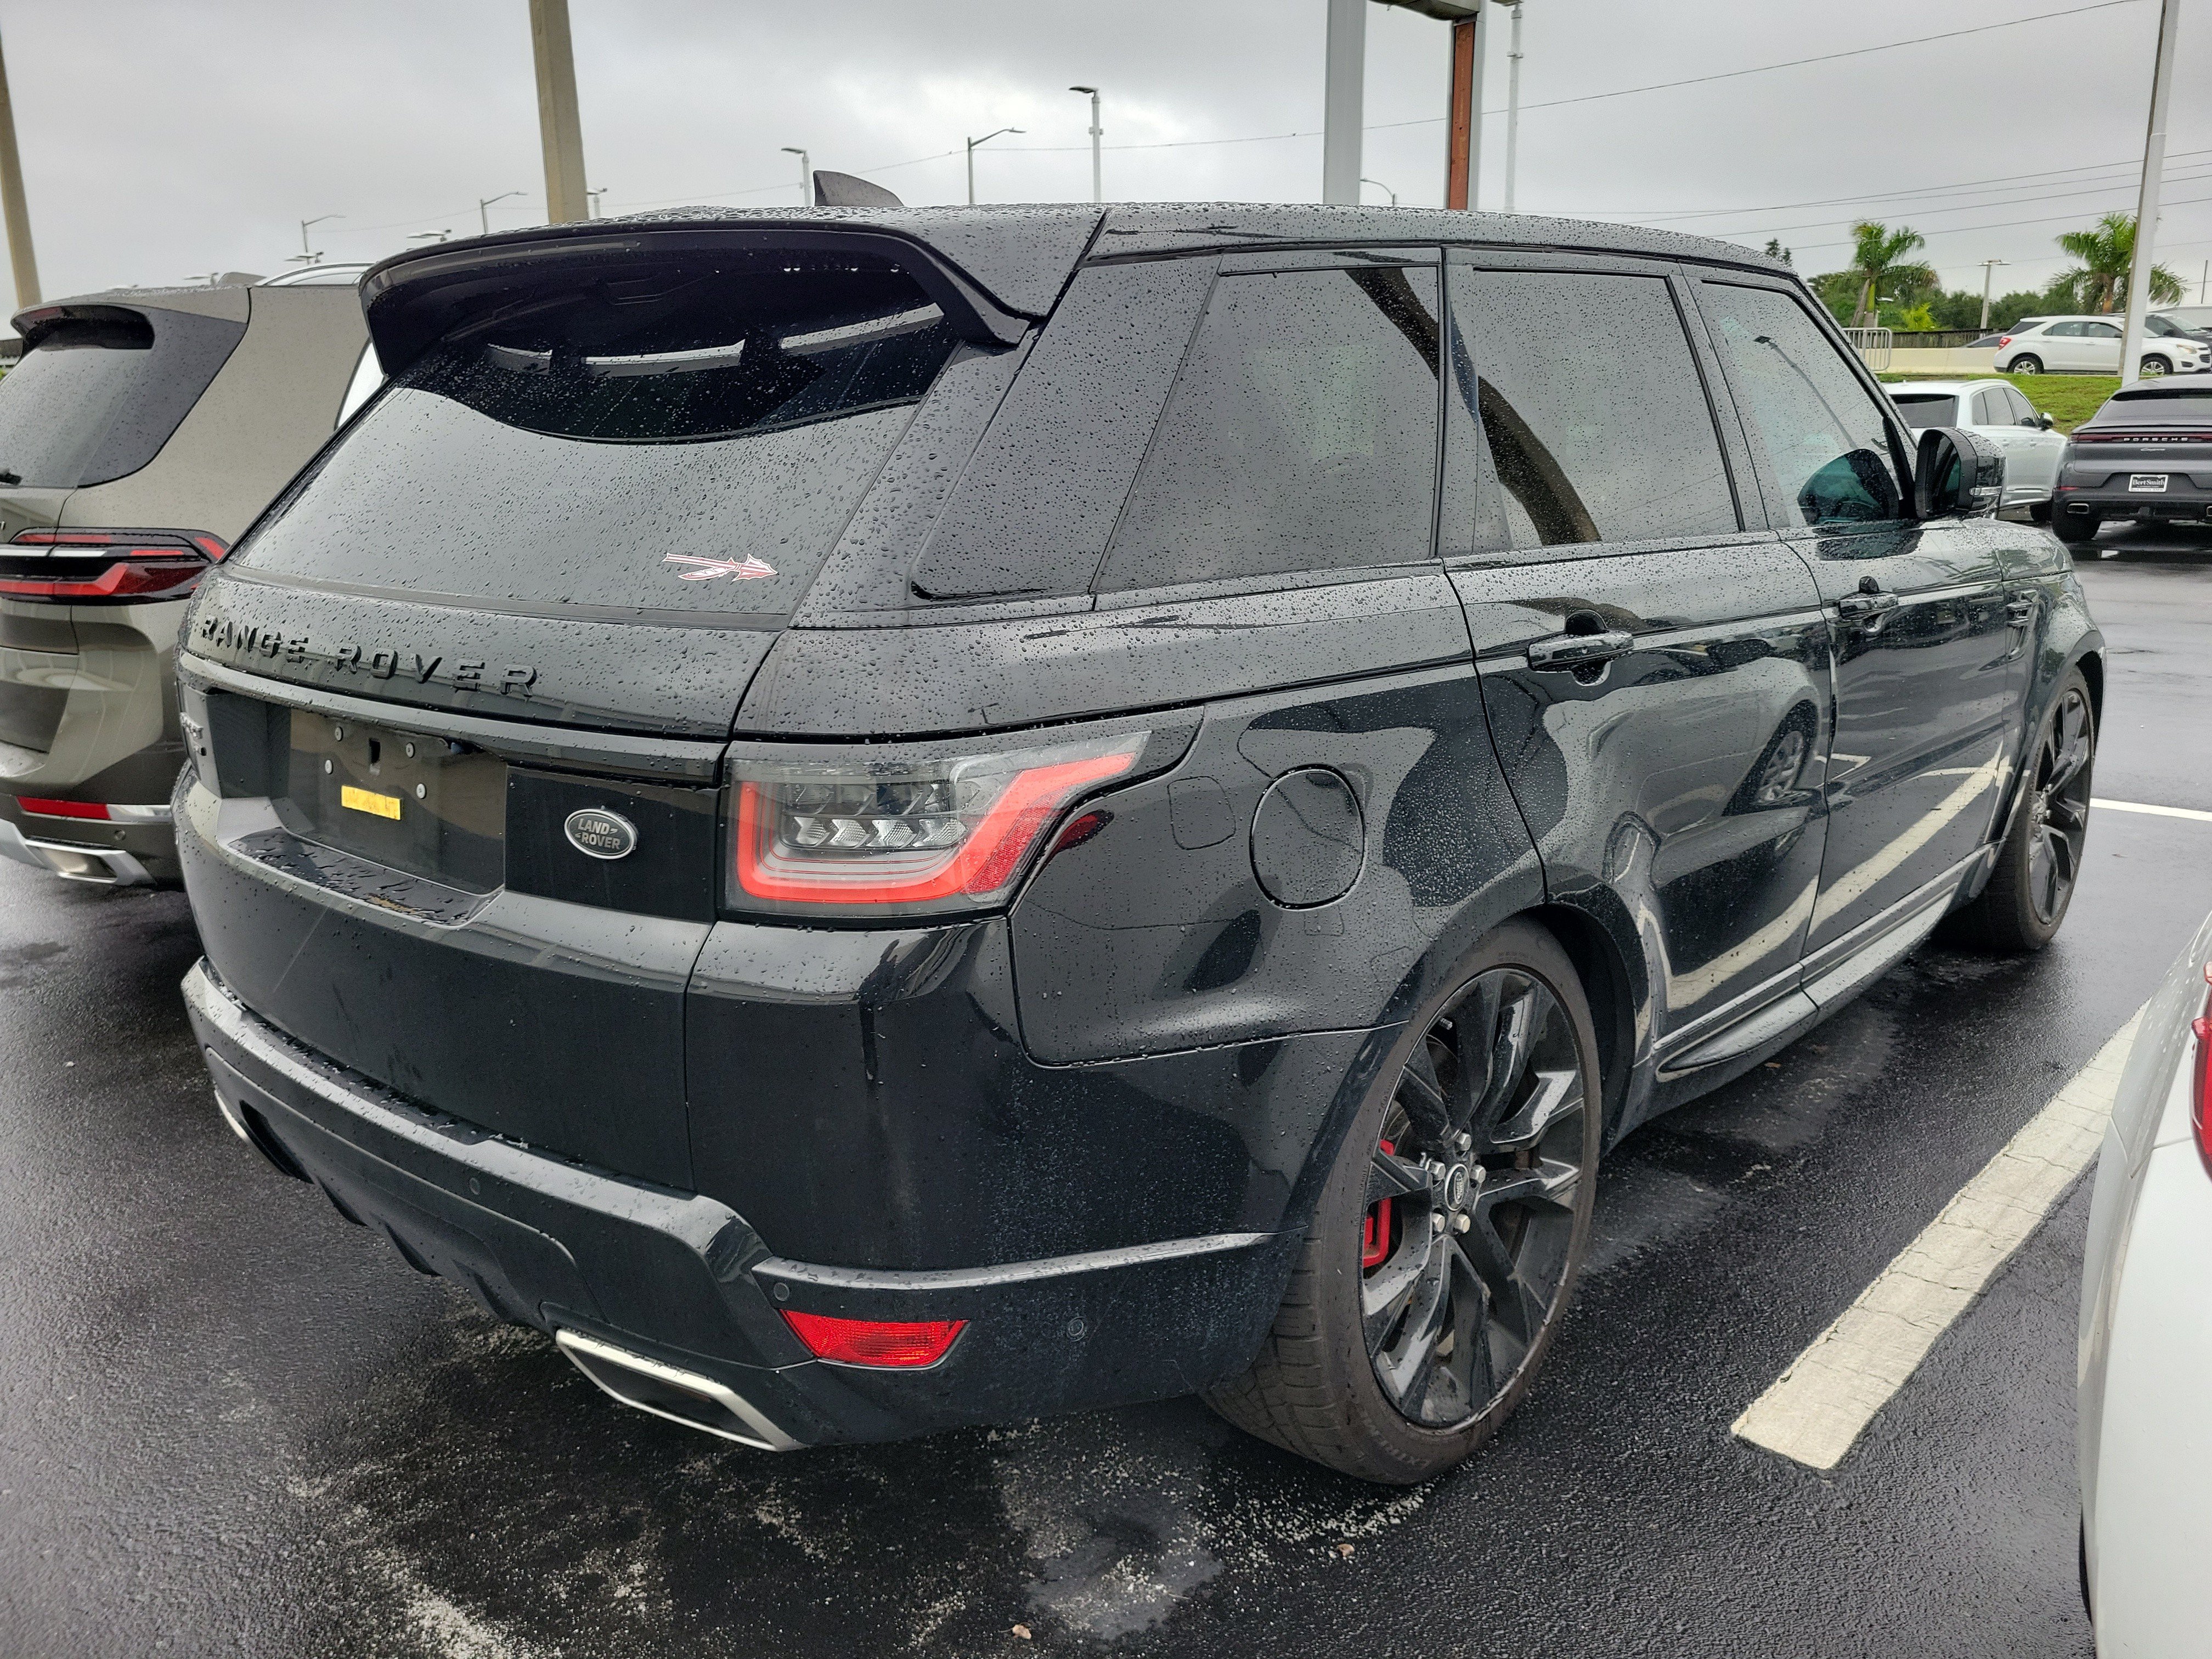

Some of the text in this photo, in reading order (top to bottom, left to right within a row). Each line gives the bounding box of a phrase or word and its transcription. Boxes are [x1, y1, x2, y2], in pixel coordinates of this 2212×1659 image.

[202, 614, 538, 698] RANGE ROVER
[578, 818, 610, 835] LAND
[581, 832, 621, 850] ROVER
